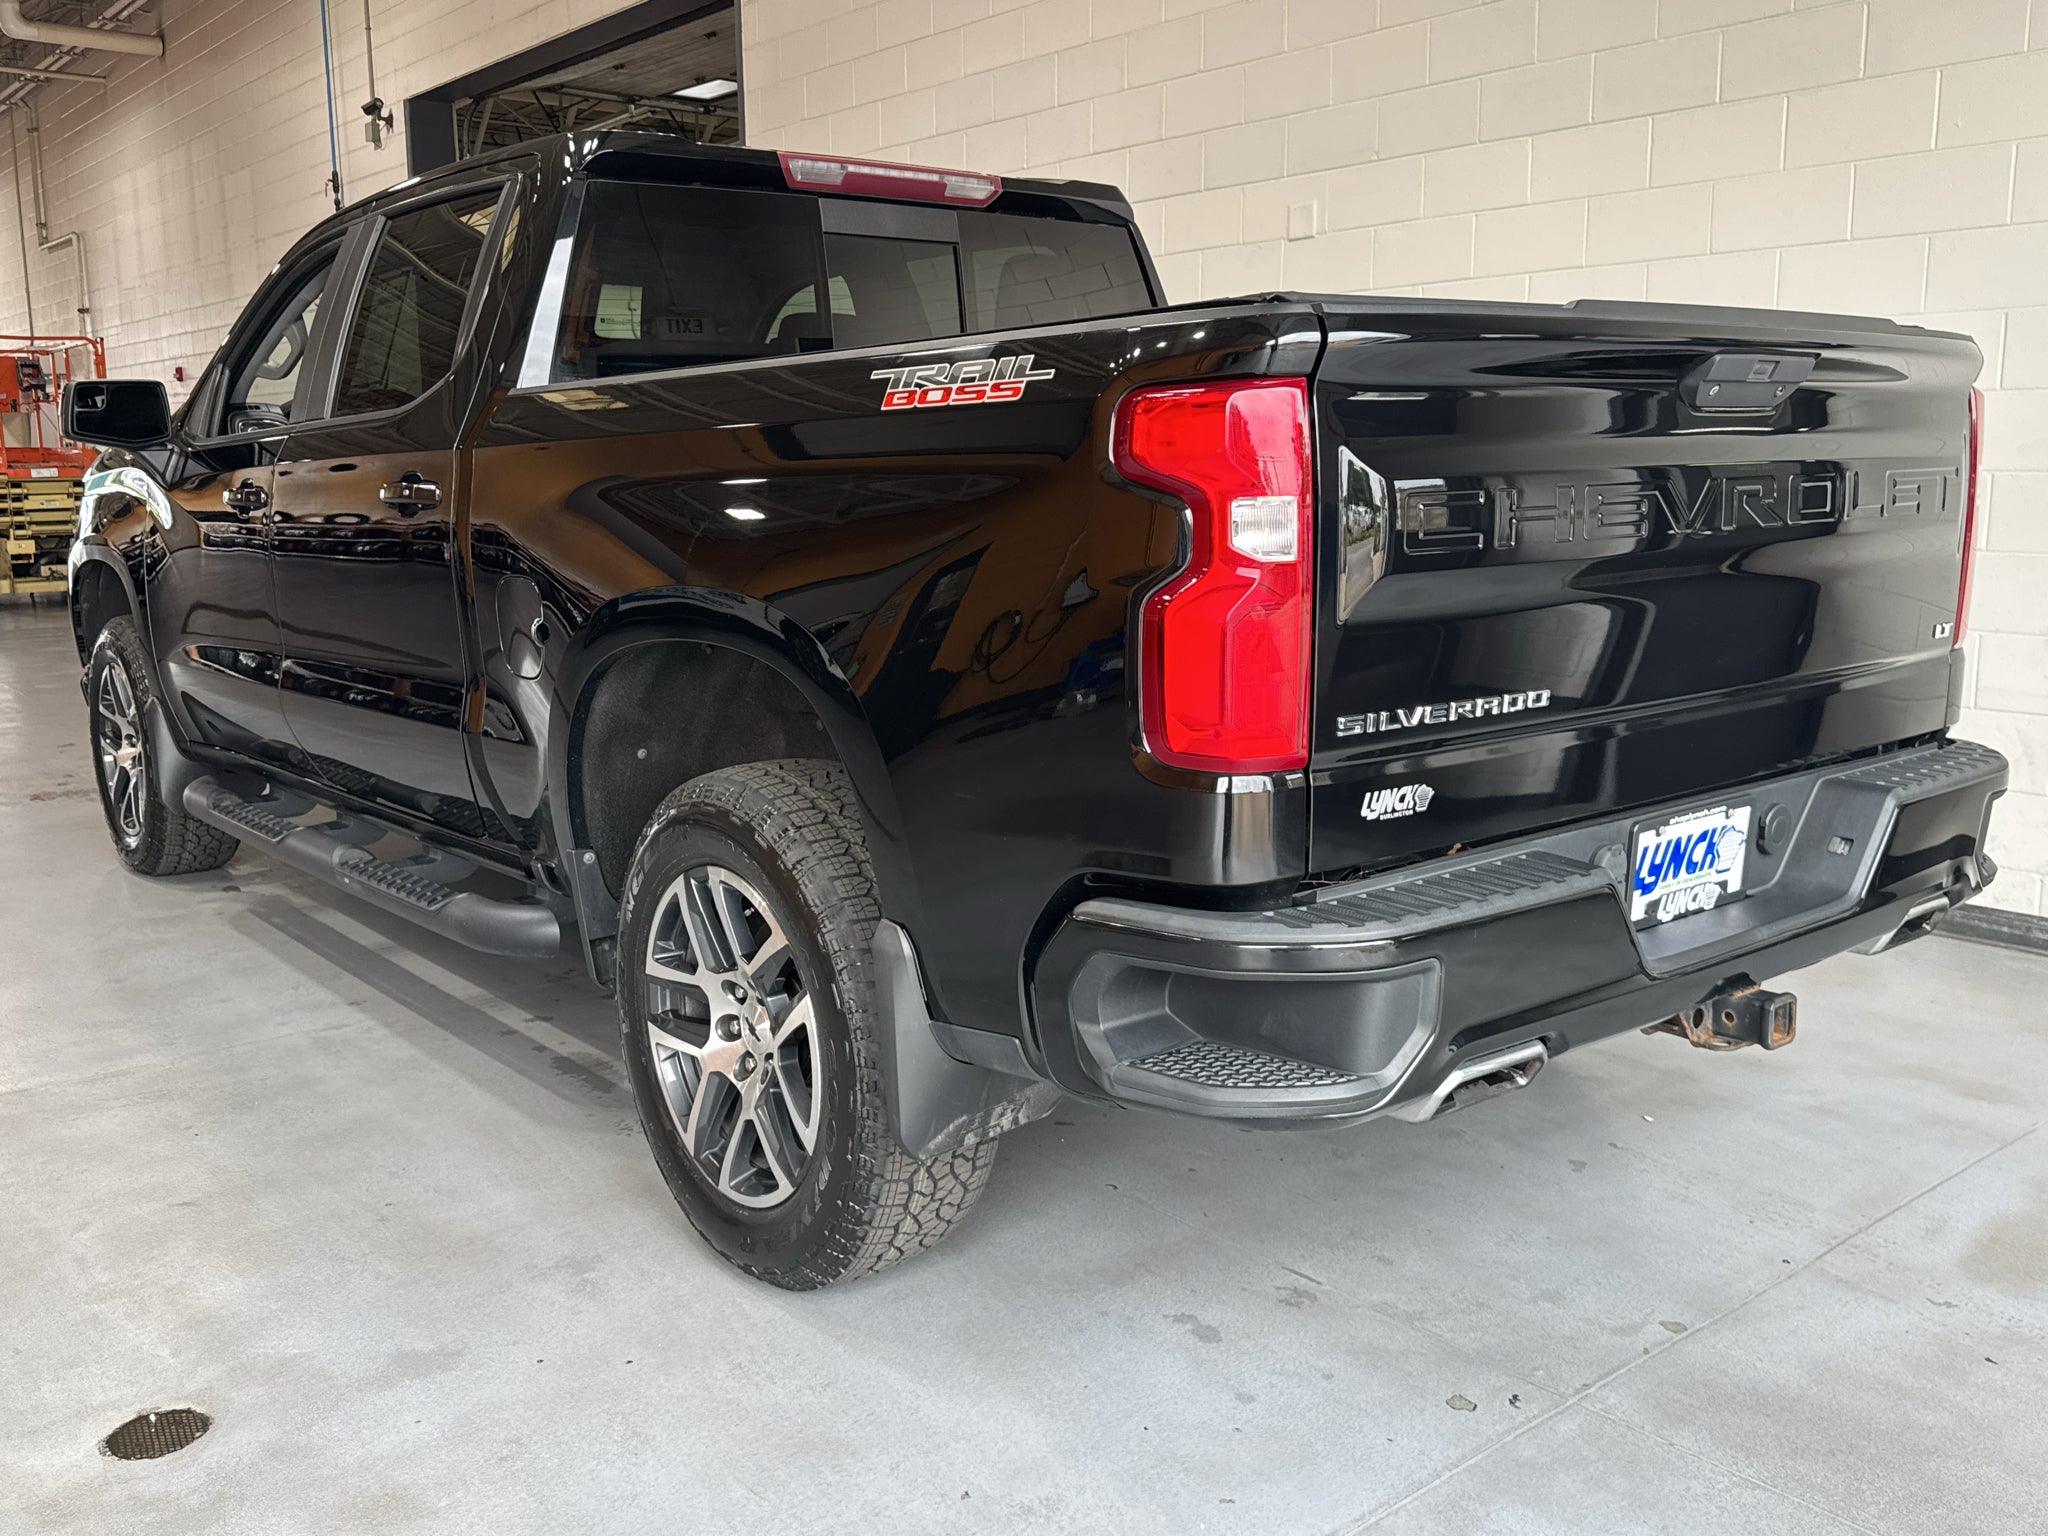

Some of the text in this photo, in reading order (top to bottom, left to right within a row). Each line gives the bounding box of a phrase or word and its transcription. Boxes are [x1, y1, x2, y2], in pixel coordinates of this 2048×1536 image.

[870, 354, 1056, 391] TRAIL
[880, 379, 1027, 411] BOSS
[1402, 465, 1960, 556] CHEVROLET
[1932, 622, 1954, 639] LT
[1336, 689, 1551, 737] SILVERADO
[1633, 824, 1728, 897] LYNCH
